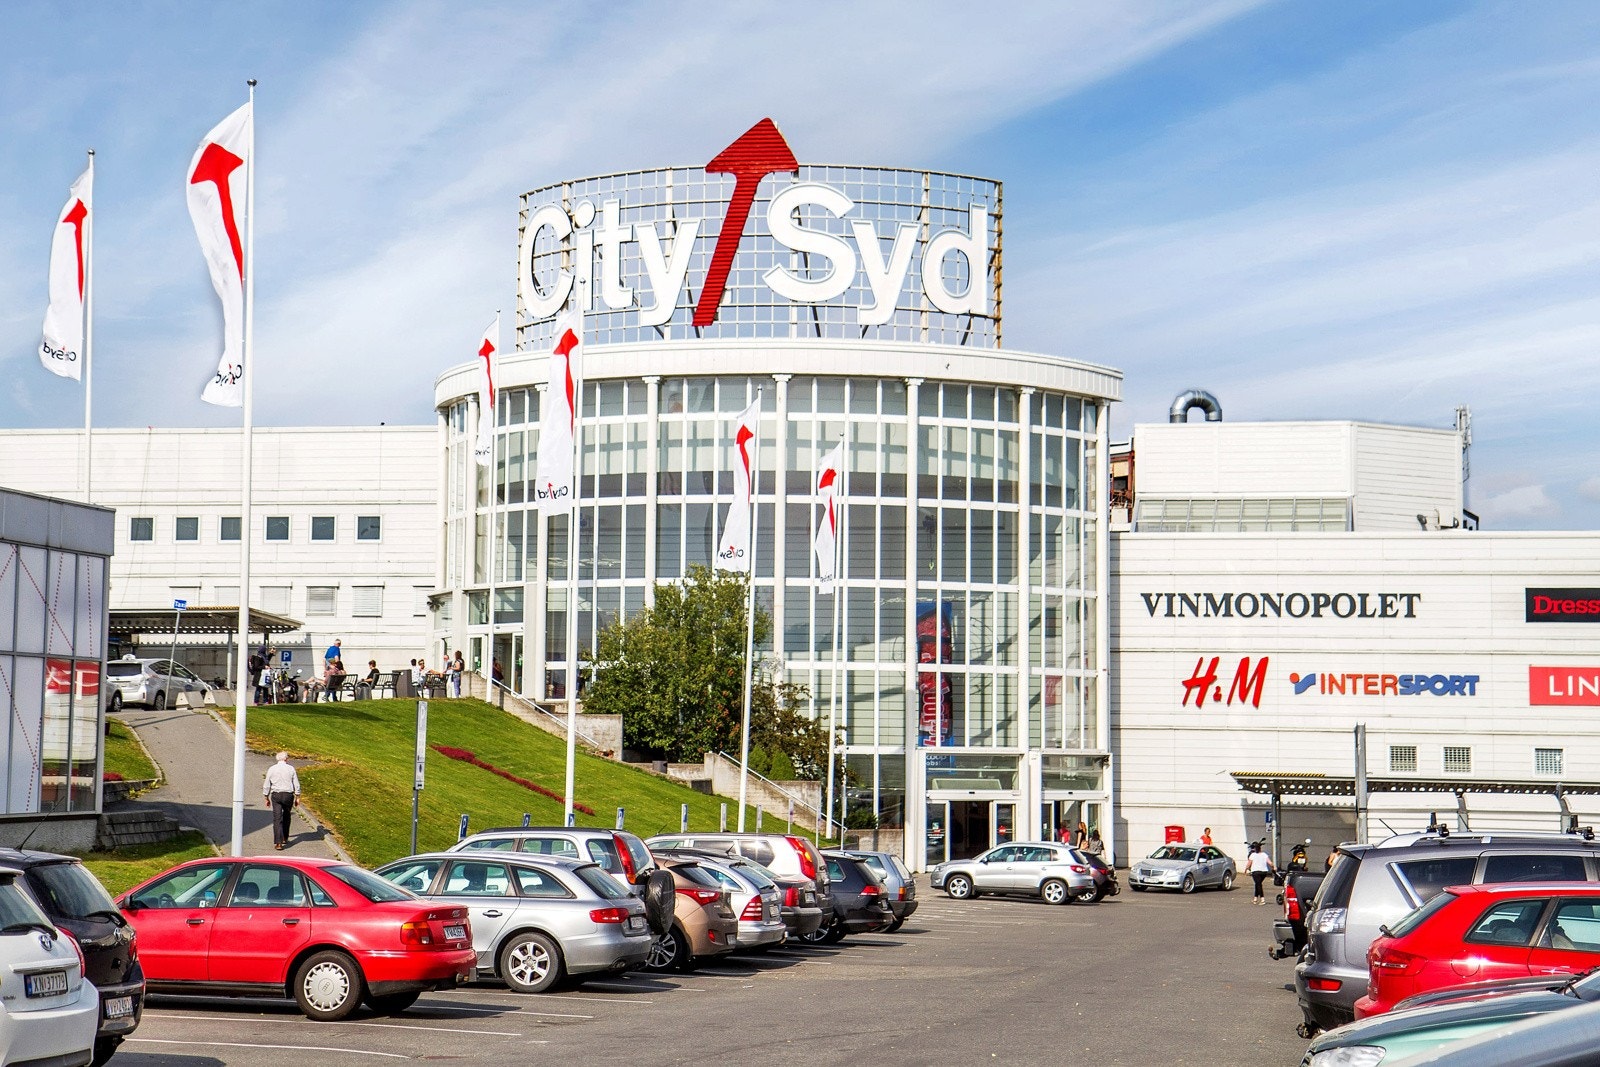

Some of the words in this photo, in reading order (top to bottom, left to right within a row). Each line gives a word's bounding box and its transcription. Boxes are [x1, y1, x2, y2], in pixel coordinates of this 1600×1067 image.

[520, 200, 701, 326] City
[762, 183, 988, 326] Syd
[1141, 593, 1421, 618] VINMONOPOLET
[1182, 656, 1270, 710] H&M
[1320, 673, 1480, 696] INTERSPORT
[1549, 675, 1600, 697] LIN
